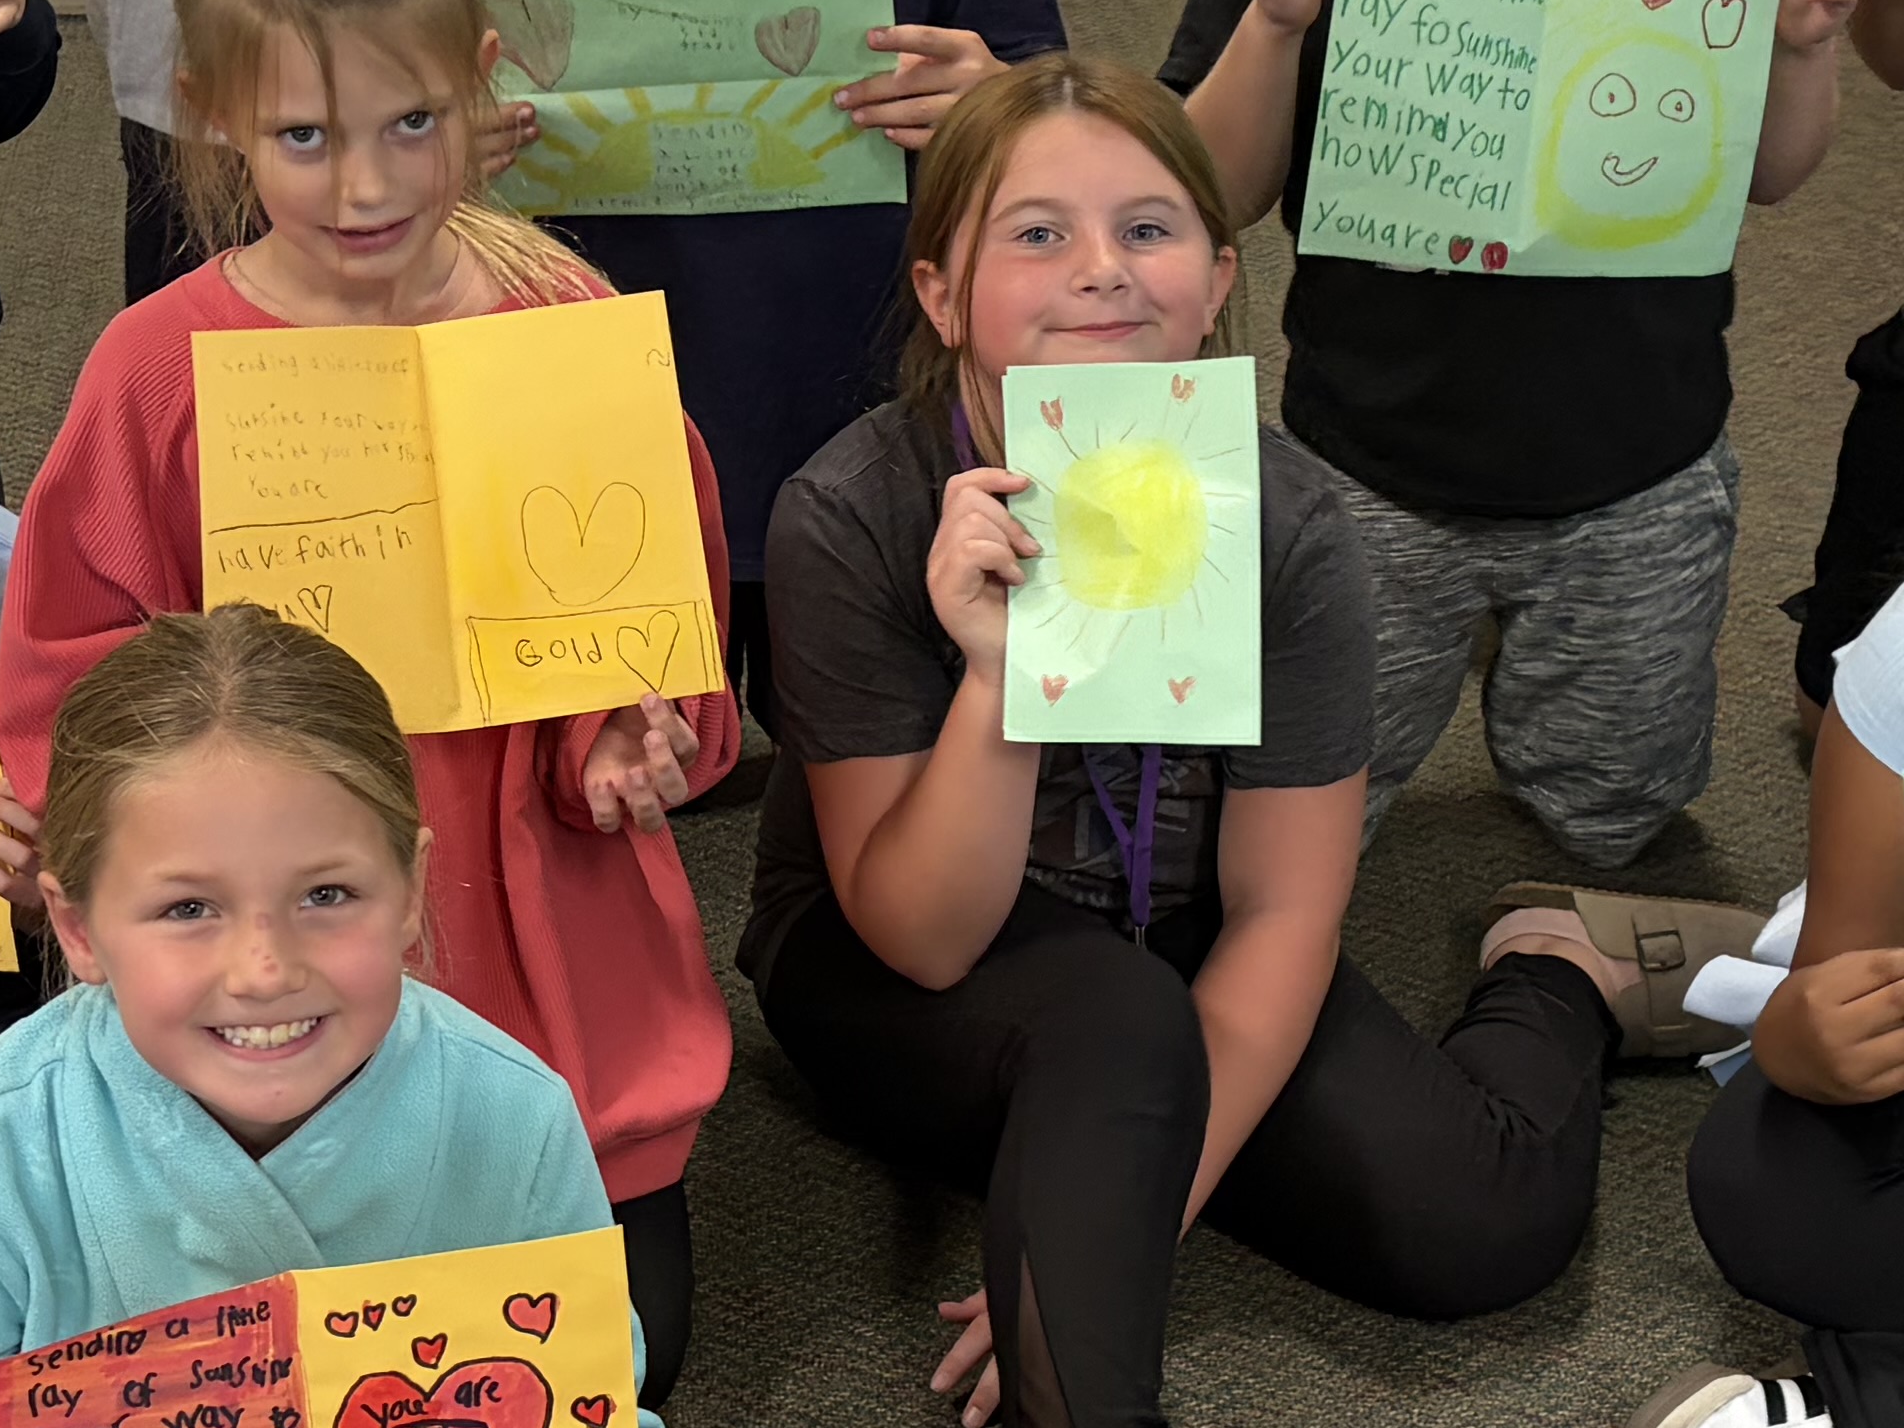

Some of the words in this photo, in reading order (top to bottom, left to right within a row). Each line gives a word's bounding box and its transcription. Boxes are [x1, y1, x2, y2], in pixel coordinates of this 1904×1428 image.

[1497, 76, 1531, 112] to
[1410, 153, 1512, 211] special
[1380, 219, 1440, 255] are
[296, 535, 366, 564] faith
[374, 525, 413, 562] in
[514, 632, 604, 668] Gold
[165, 1319, 190, 1337] a
[27, 1383, 83, 1418] ray
[123, 1373, 158, 1407] of
[454, 1378, 503, 1409] are
